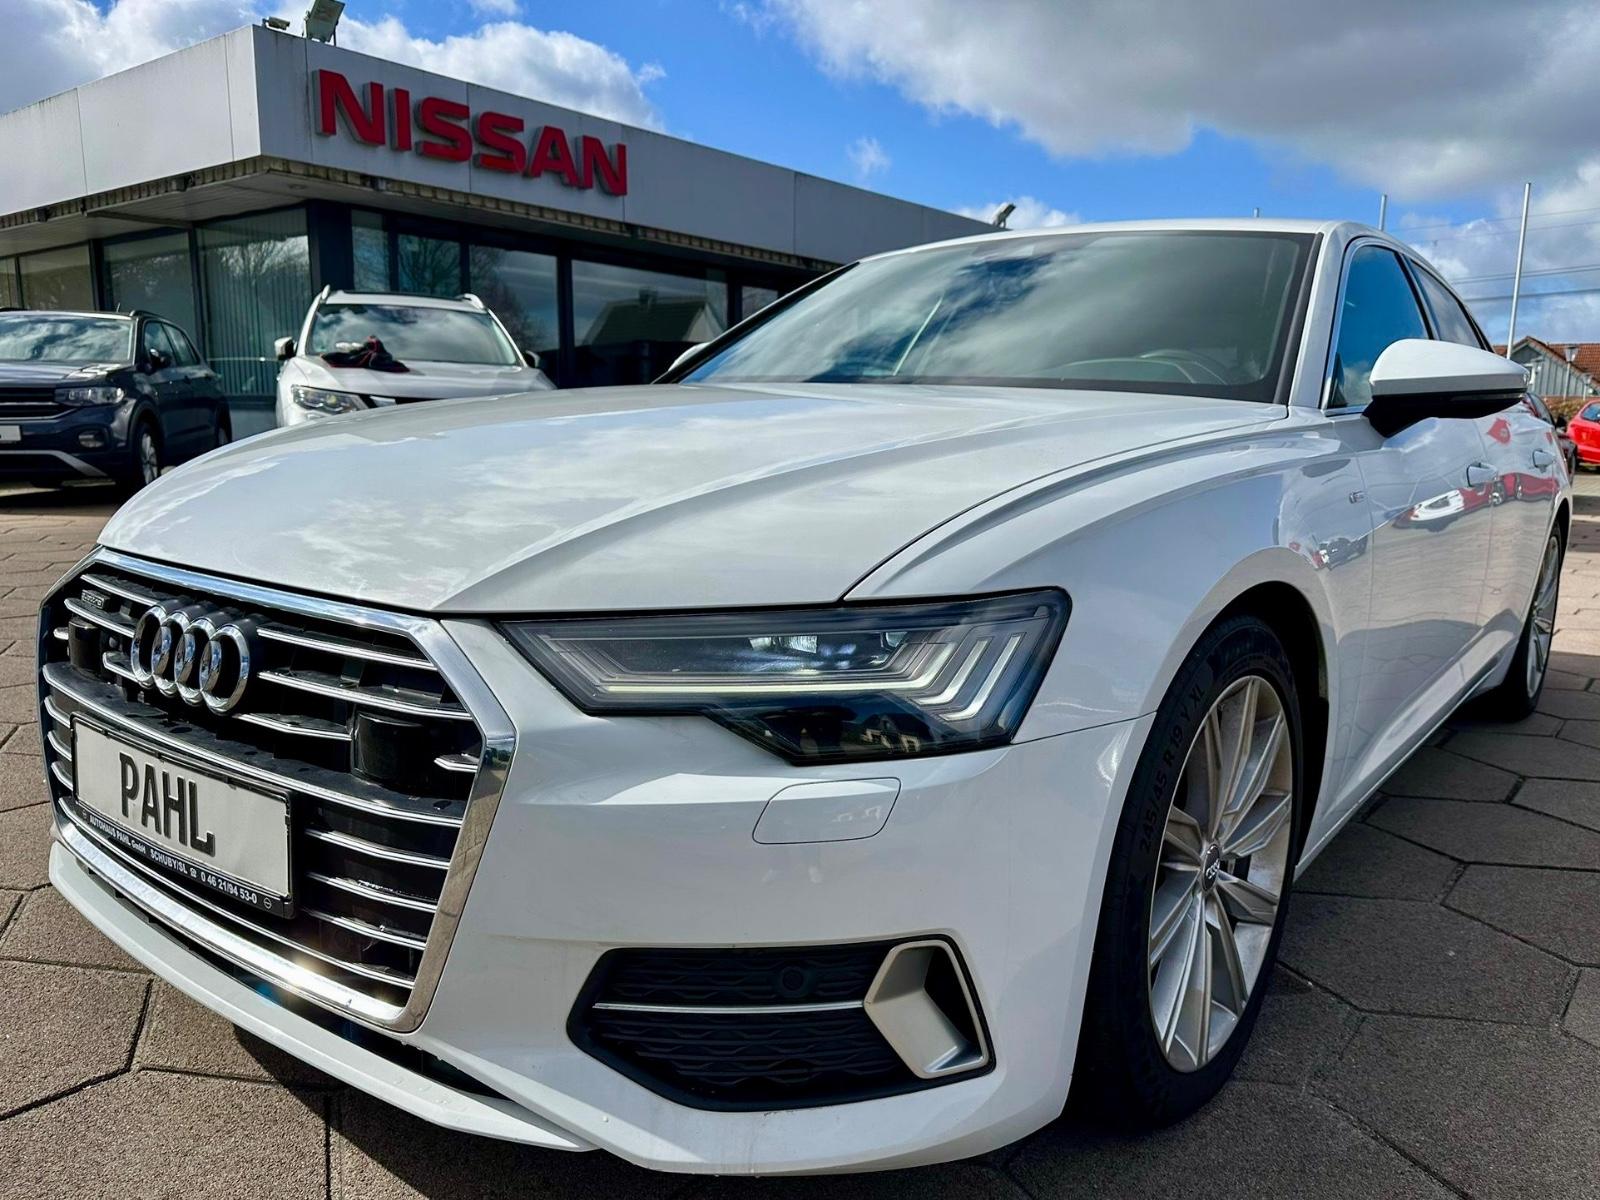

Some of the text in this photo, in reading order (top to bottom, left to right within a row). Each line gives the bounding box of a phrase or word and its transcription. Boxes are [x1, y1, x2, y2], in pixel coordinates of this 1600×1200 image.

[315, 68, 628, 196] NISSAN
[1170, 724, 1184, 748] 19
[120, 752, 215, 857] PAHL
[90, 815, 258, 904] AUTOHAUS PAHL GmbH SCHUBY/SL 0 46 21/94 53-0
